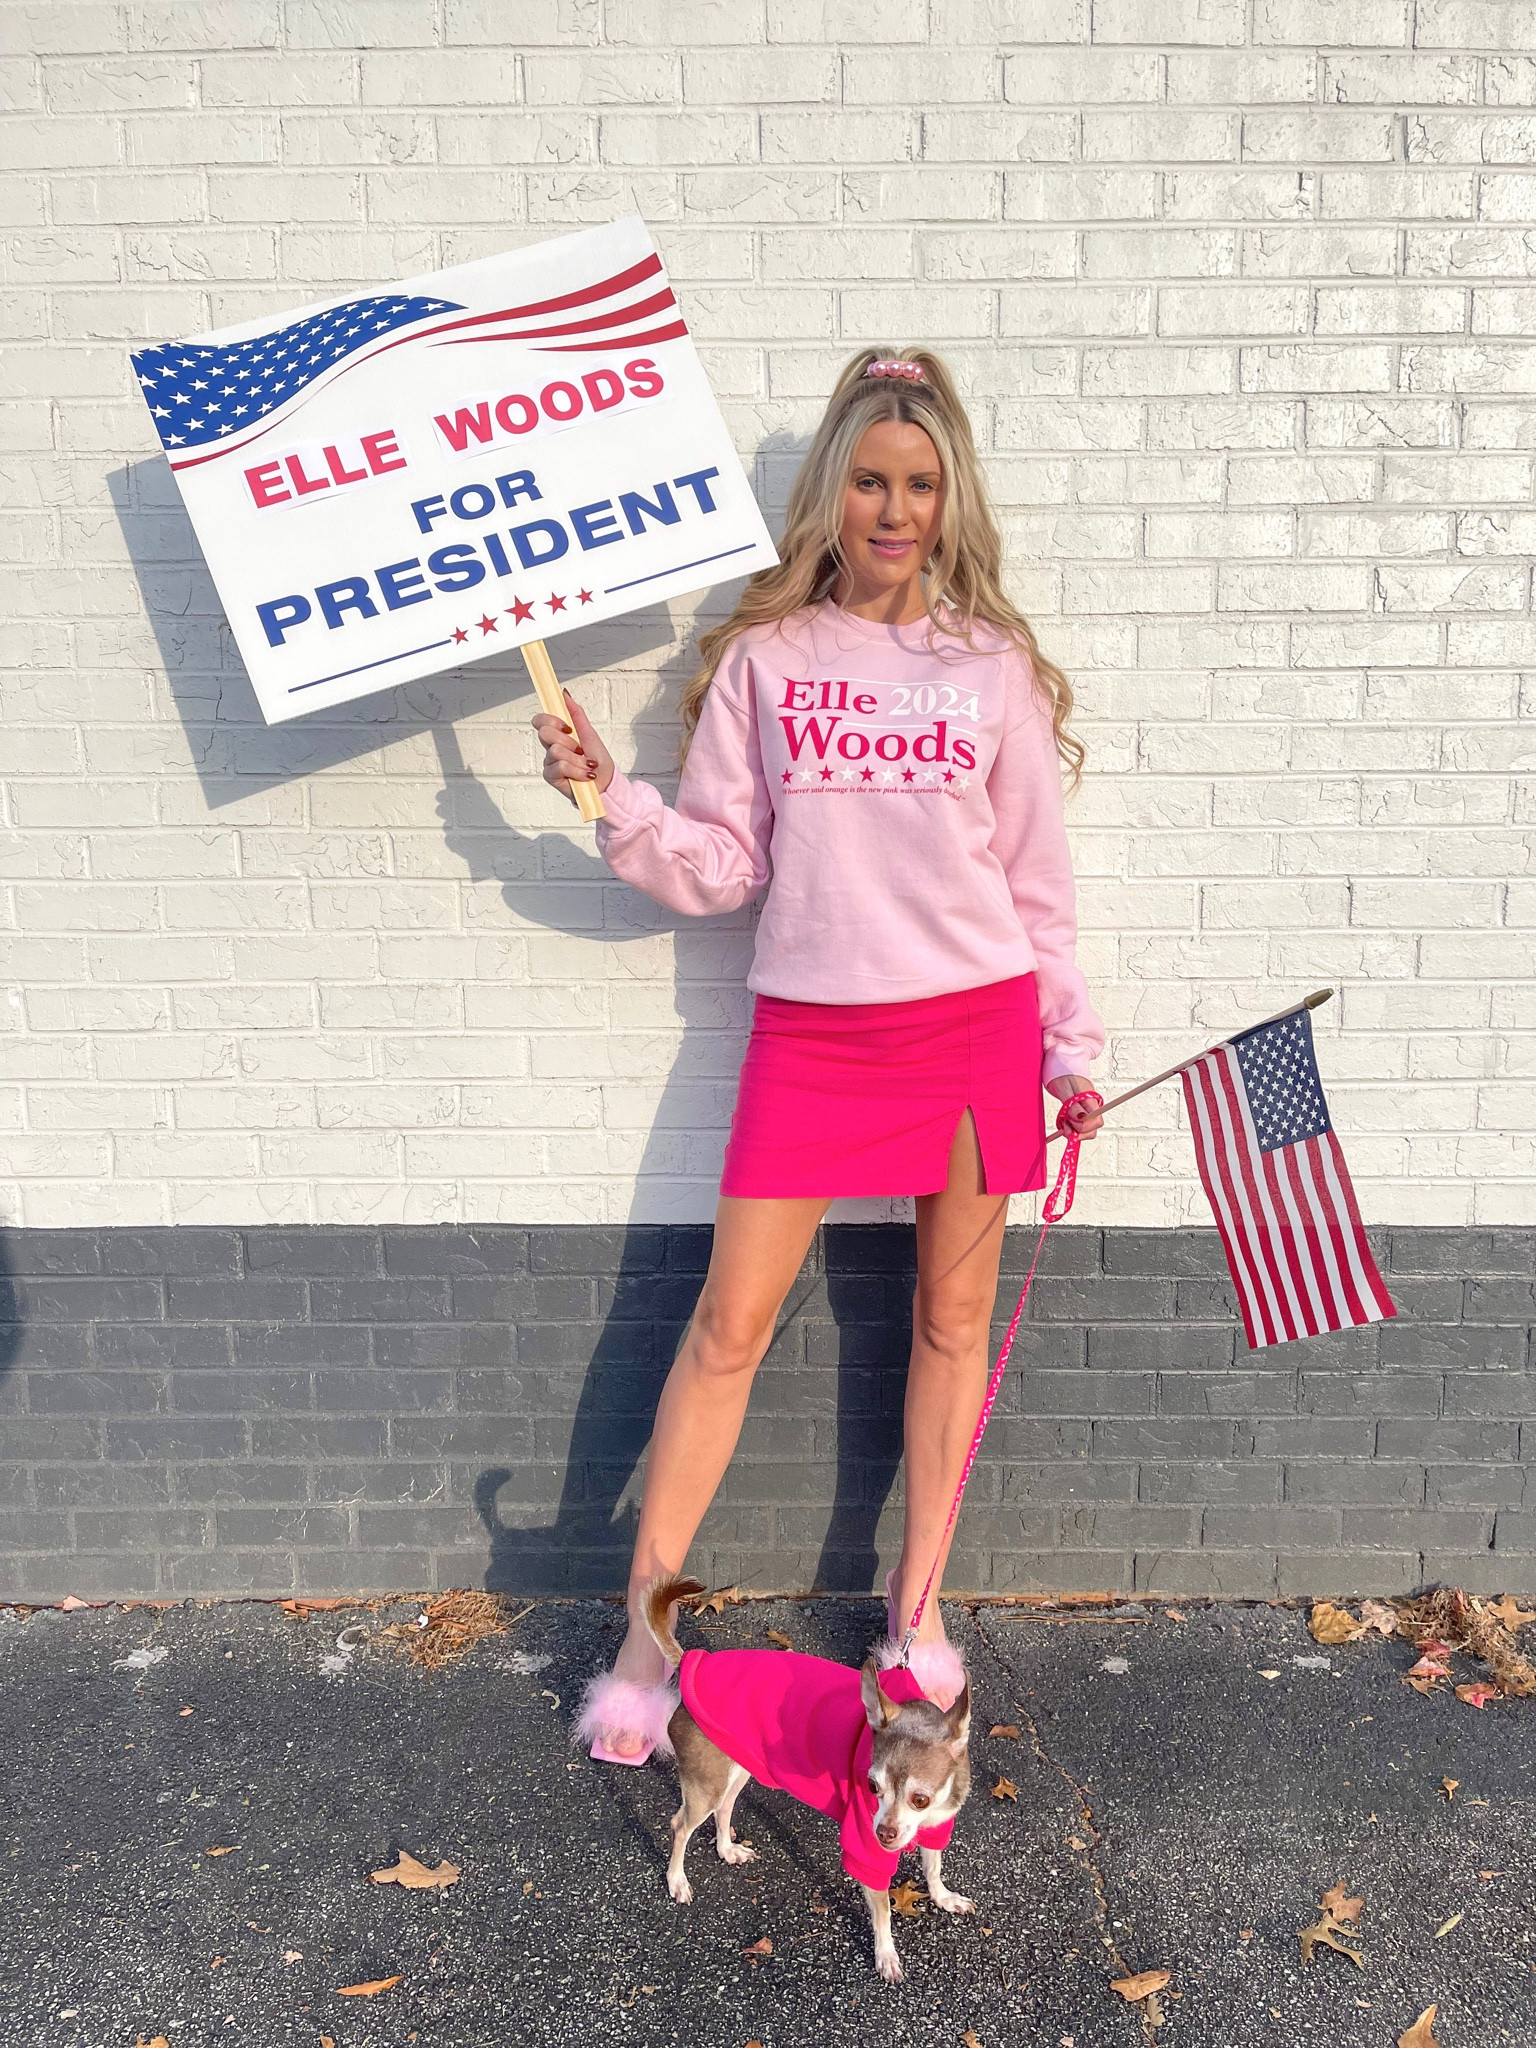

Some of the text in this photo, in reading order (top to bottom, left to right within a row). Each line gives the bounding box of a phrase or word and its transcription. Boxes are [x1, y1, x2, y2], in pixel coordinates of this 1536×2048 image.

[243, 358, 665, 509] ELLE WOODS
[411, 469, 543, 534] FOR
[256, 466, 720, 648] PRESIDENT
[778, 676, 981, 723] Elle 2024
[778, 716, 977, 770] Woods
[825, 787, 848, 795] orange
[882, 787, 898, 795] pink
[913, 786, 942, 795] seriously
